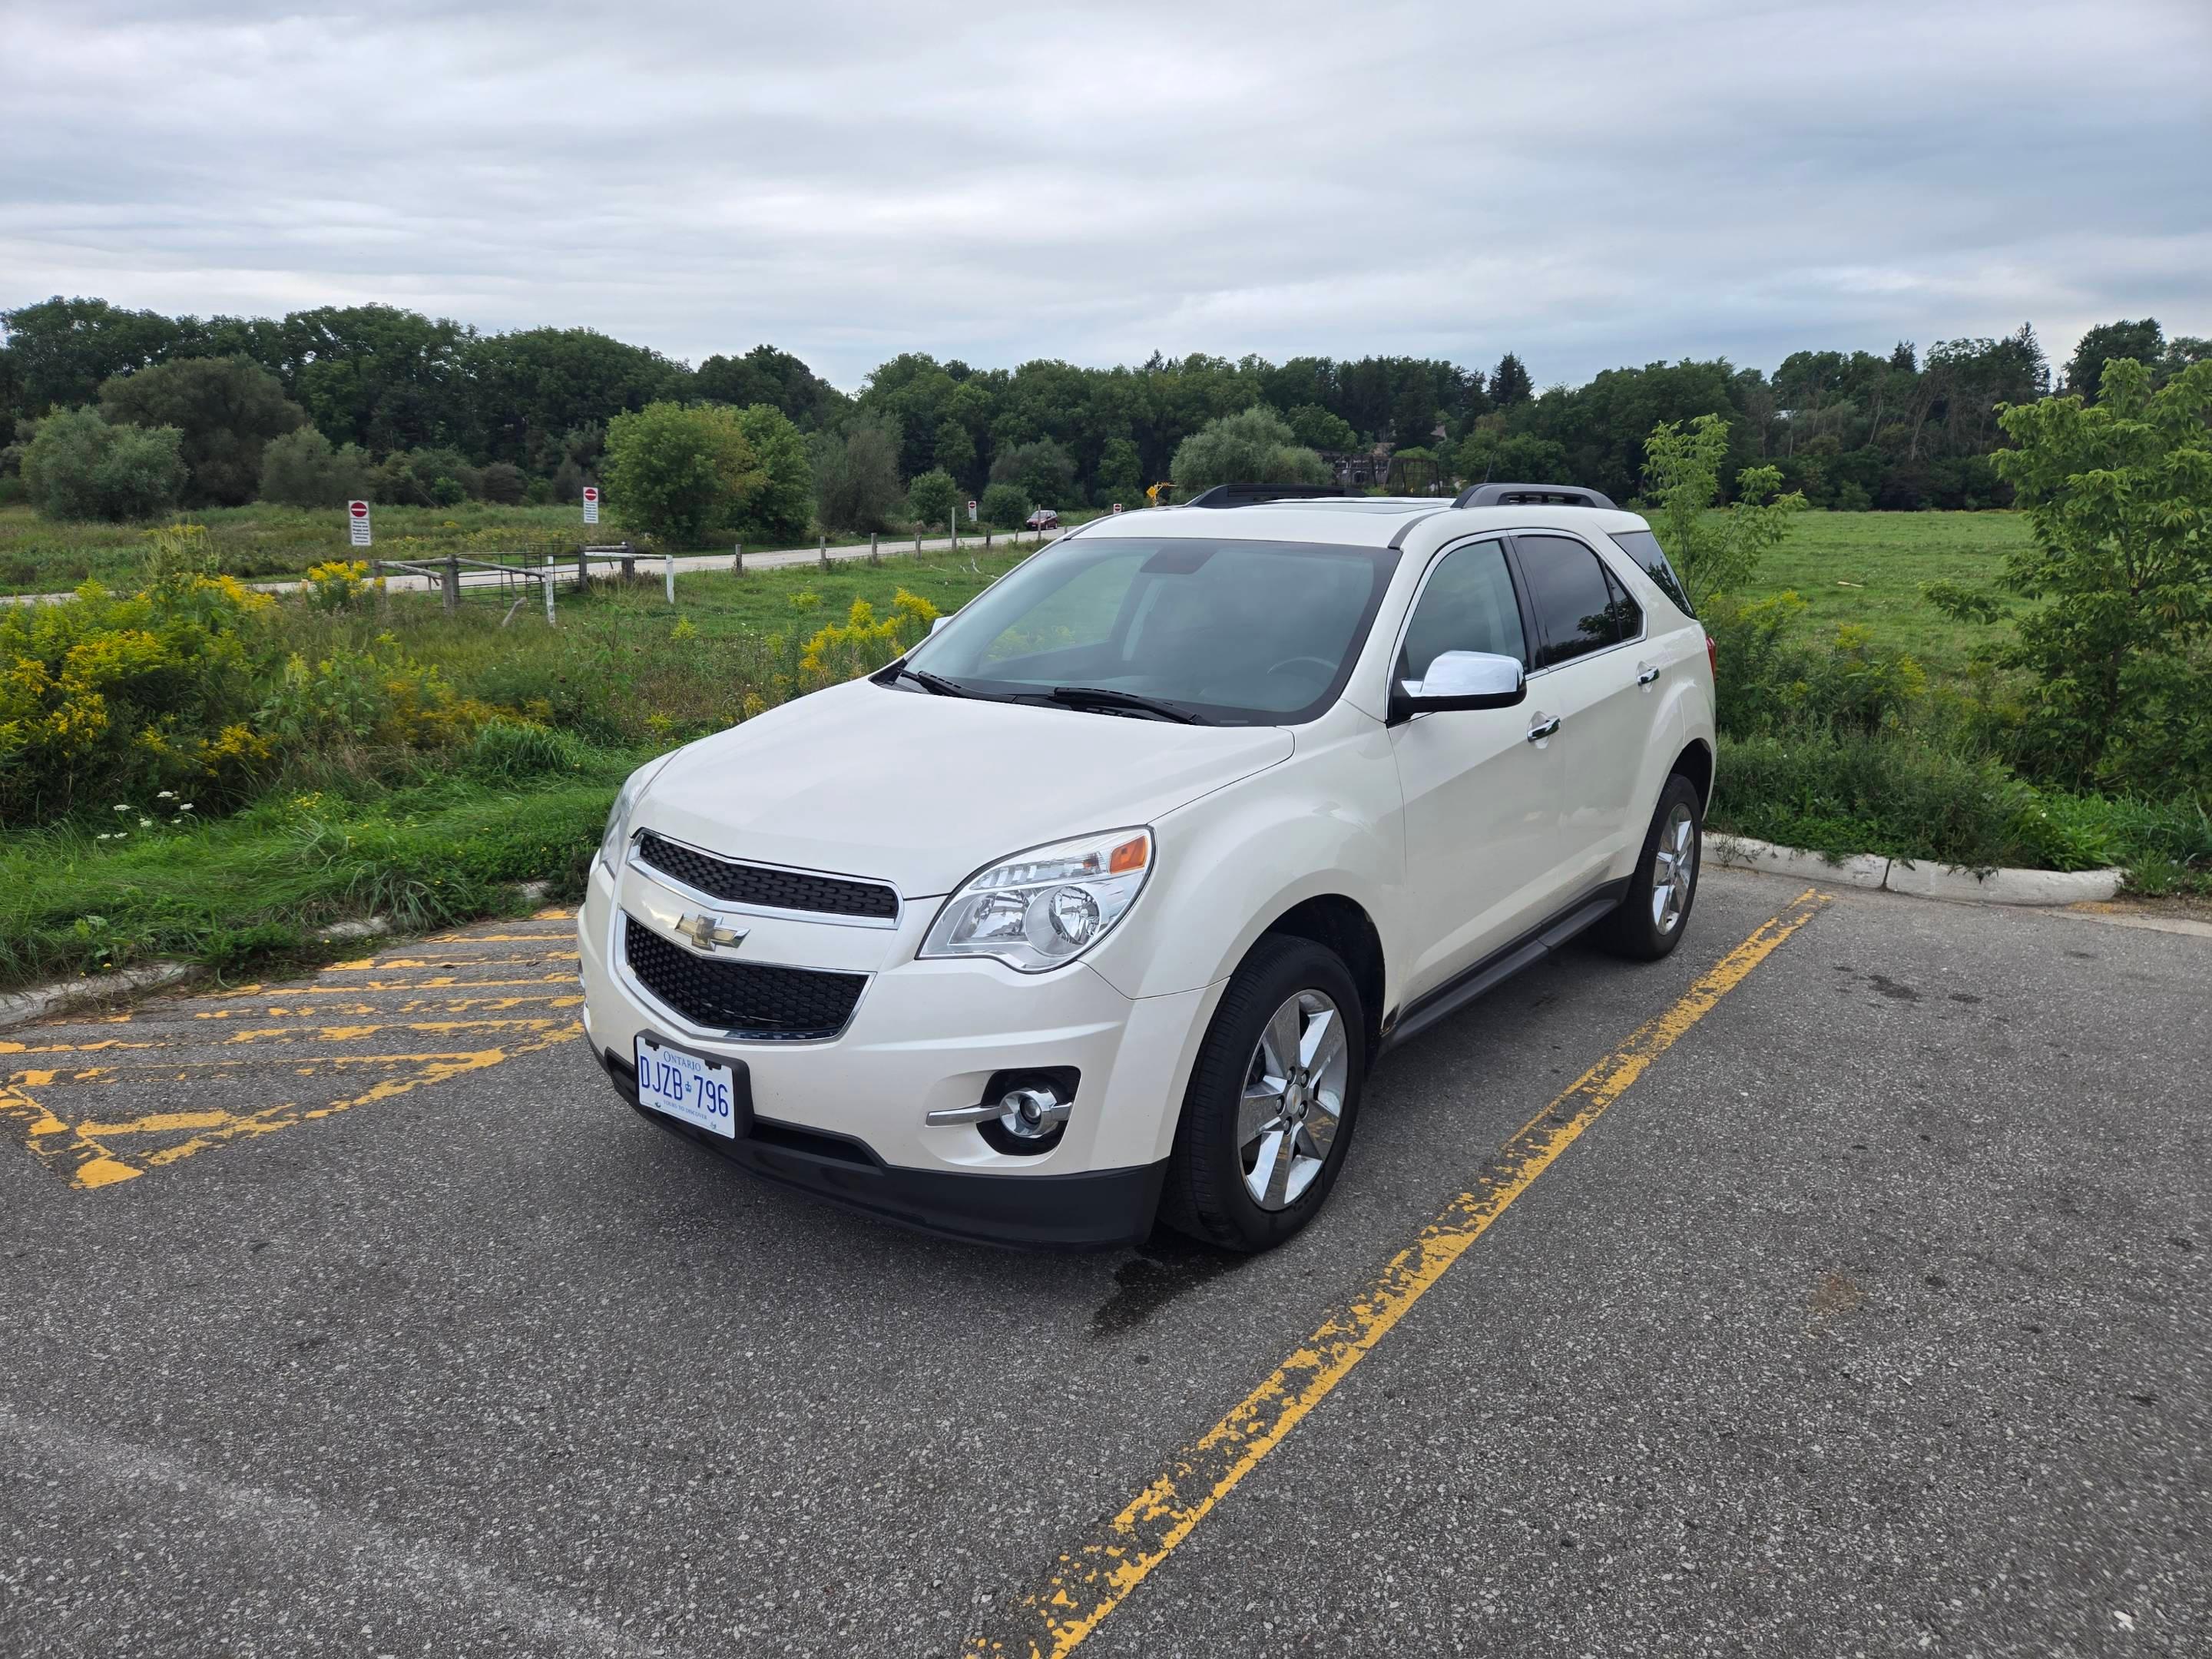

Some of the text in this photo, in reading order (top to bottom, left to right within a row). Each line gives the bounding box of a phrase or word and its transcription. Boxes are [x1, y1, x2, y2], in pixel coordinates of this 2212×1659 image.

[664, 1051, 701, 1071] ONTARIO
[640, 1055, 728, 1118] DJZB 796
[664, 1100, 677, 1108] YOURS
[685, 1108, 707, 1120] DISCOVER
